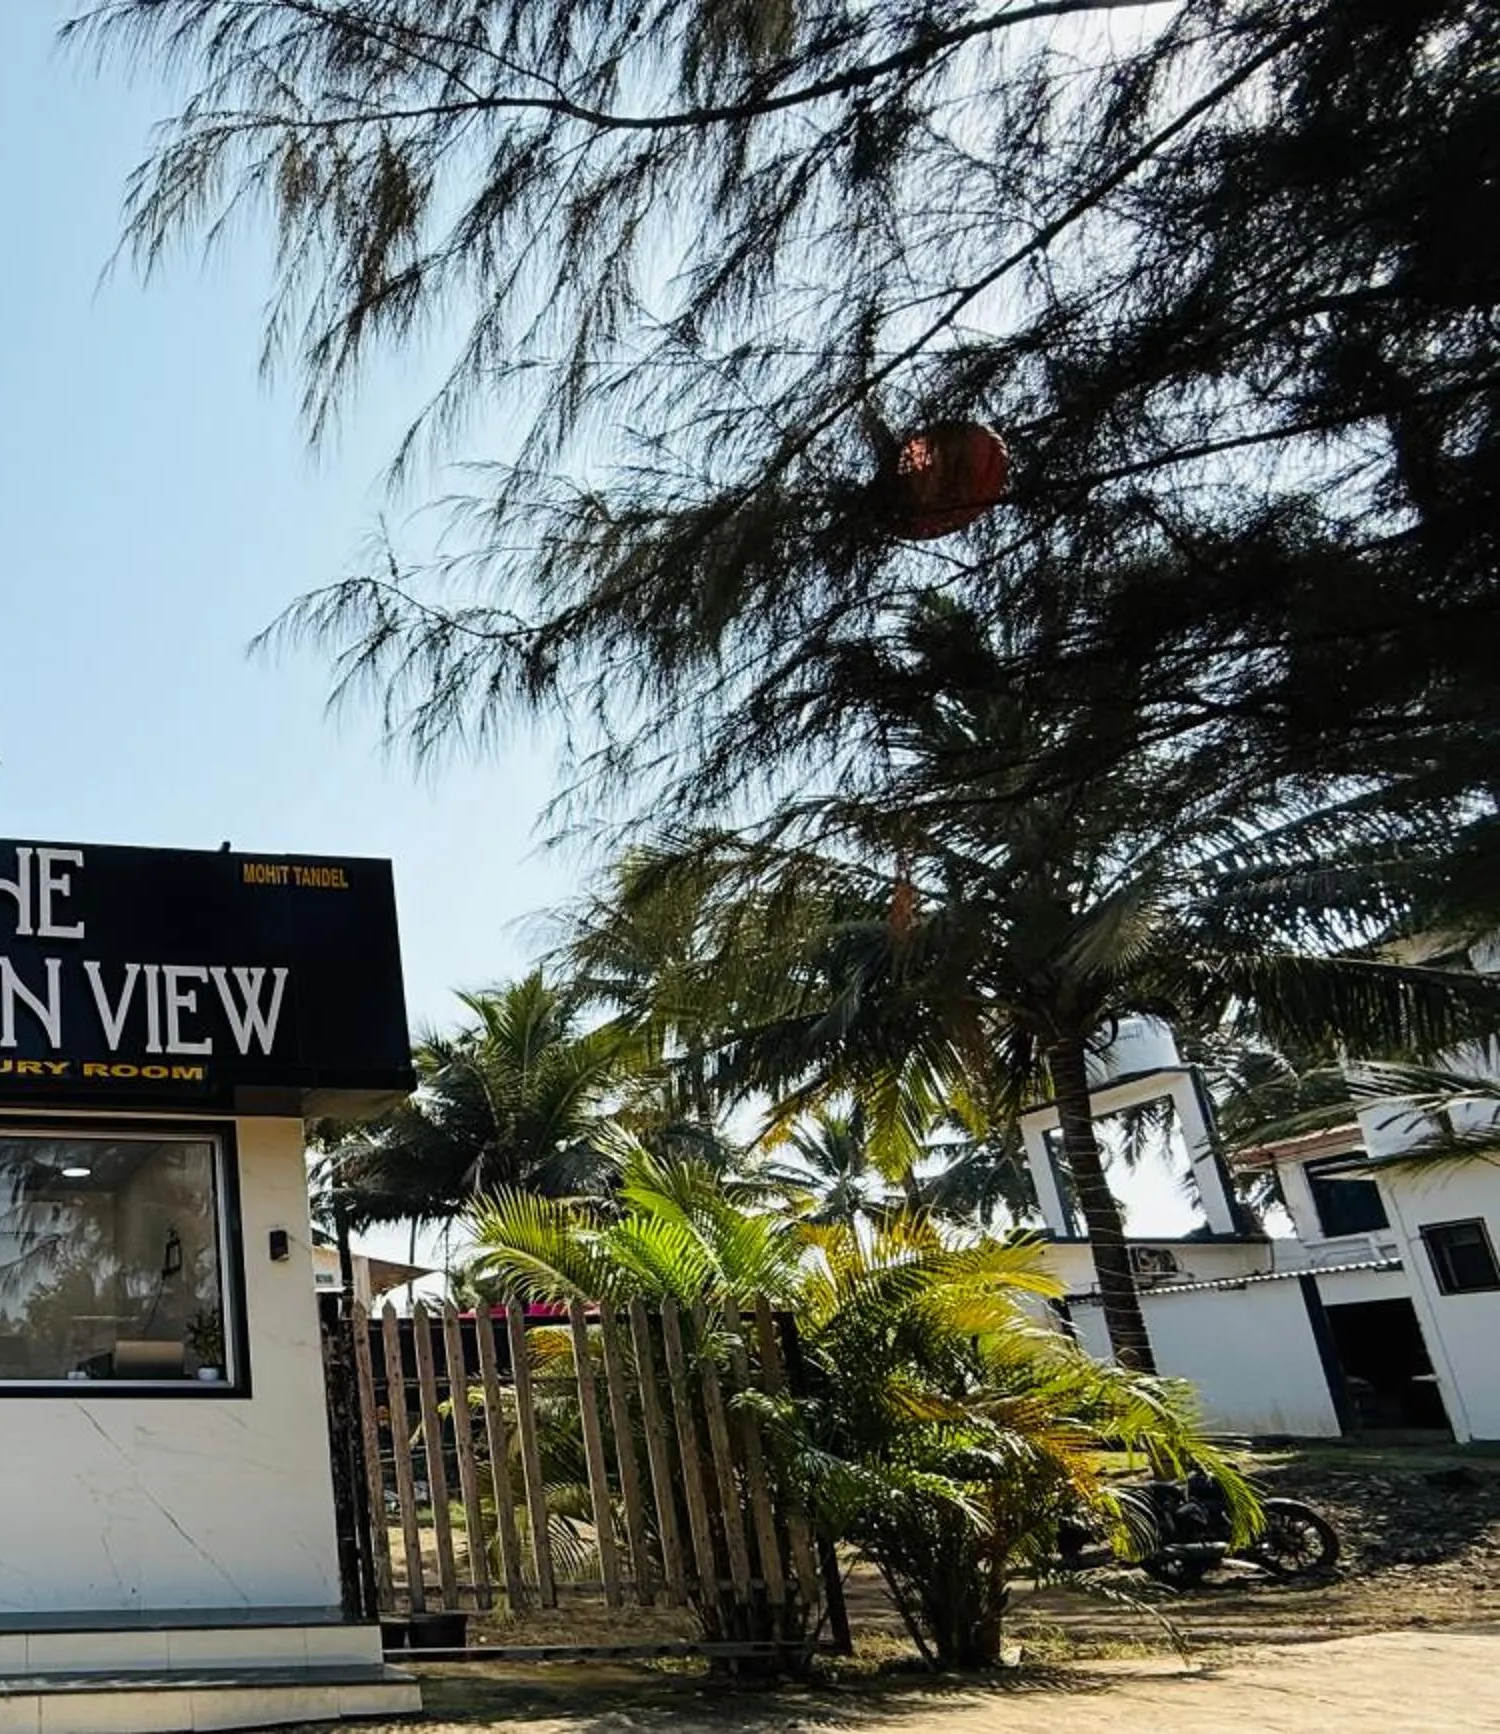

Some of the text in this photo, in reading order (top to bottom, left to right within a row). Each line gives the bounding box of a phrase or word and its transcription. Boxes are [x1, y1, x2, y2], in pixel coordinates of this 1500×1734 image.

[243, 863, 349, 889] MOHIT TANDEL
[83, 960, 289, 1056] VIEW
[83, 1062, 205, 1081] ROOM
